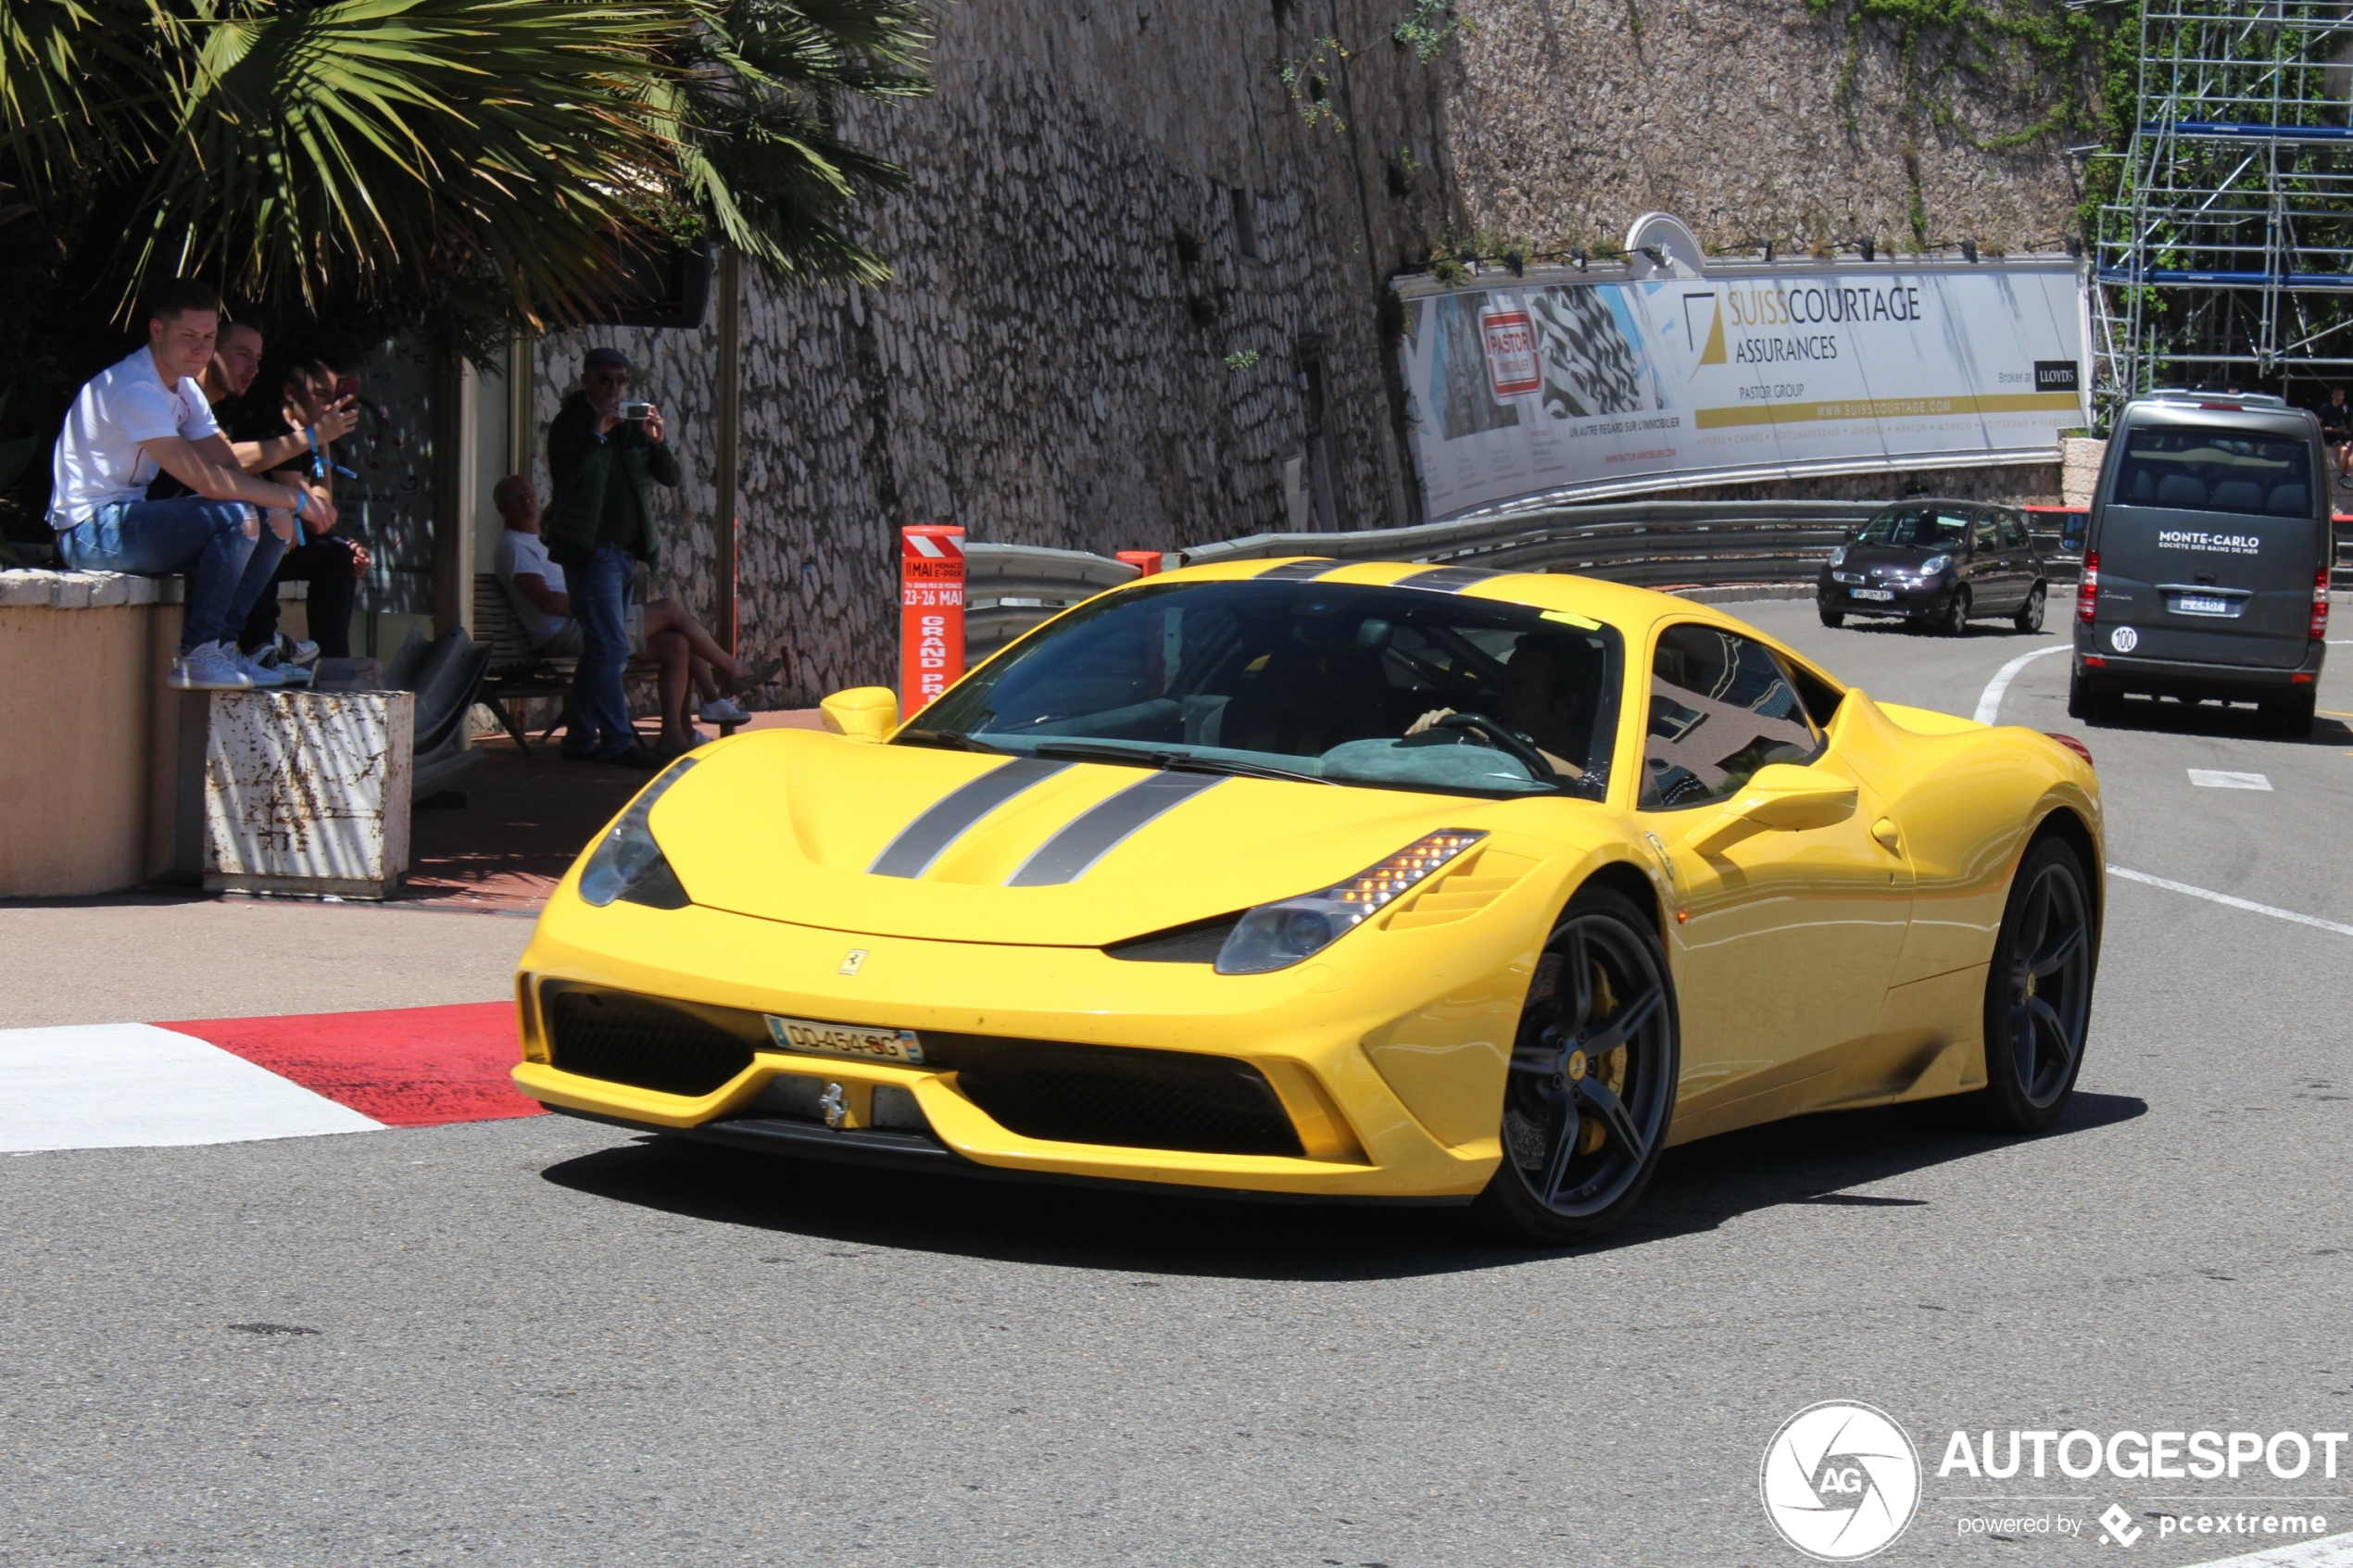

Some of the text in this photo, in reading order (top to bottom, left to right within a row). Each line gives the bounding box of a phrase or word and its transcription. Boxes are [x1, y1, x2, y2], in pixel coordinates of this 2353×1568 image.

[1729, 287, 1921, 327] SUISSCOURTAGE
[1490, 332, 1530, 356] PASTOR
[1736, 335, 1837, 364] ASSURANCES
[1999, 372, 2032, 383] Broker at
[1740, 383, 1805, 400] PASTOR GROUP
[1579, 425, 1598, 436] AUTRE
[1599, 422, 1623, 434] REGARD
[1625, 420, 1638, 432] SUR
[912, 562, 933, 576] MAI
[904, 590, 963, 606] 23-26 MAI
[920, 616, 946, 668] GRAND
[2116, 632, 2133, 648] 100
